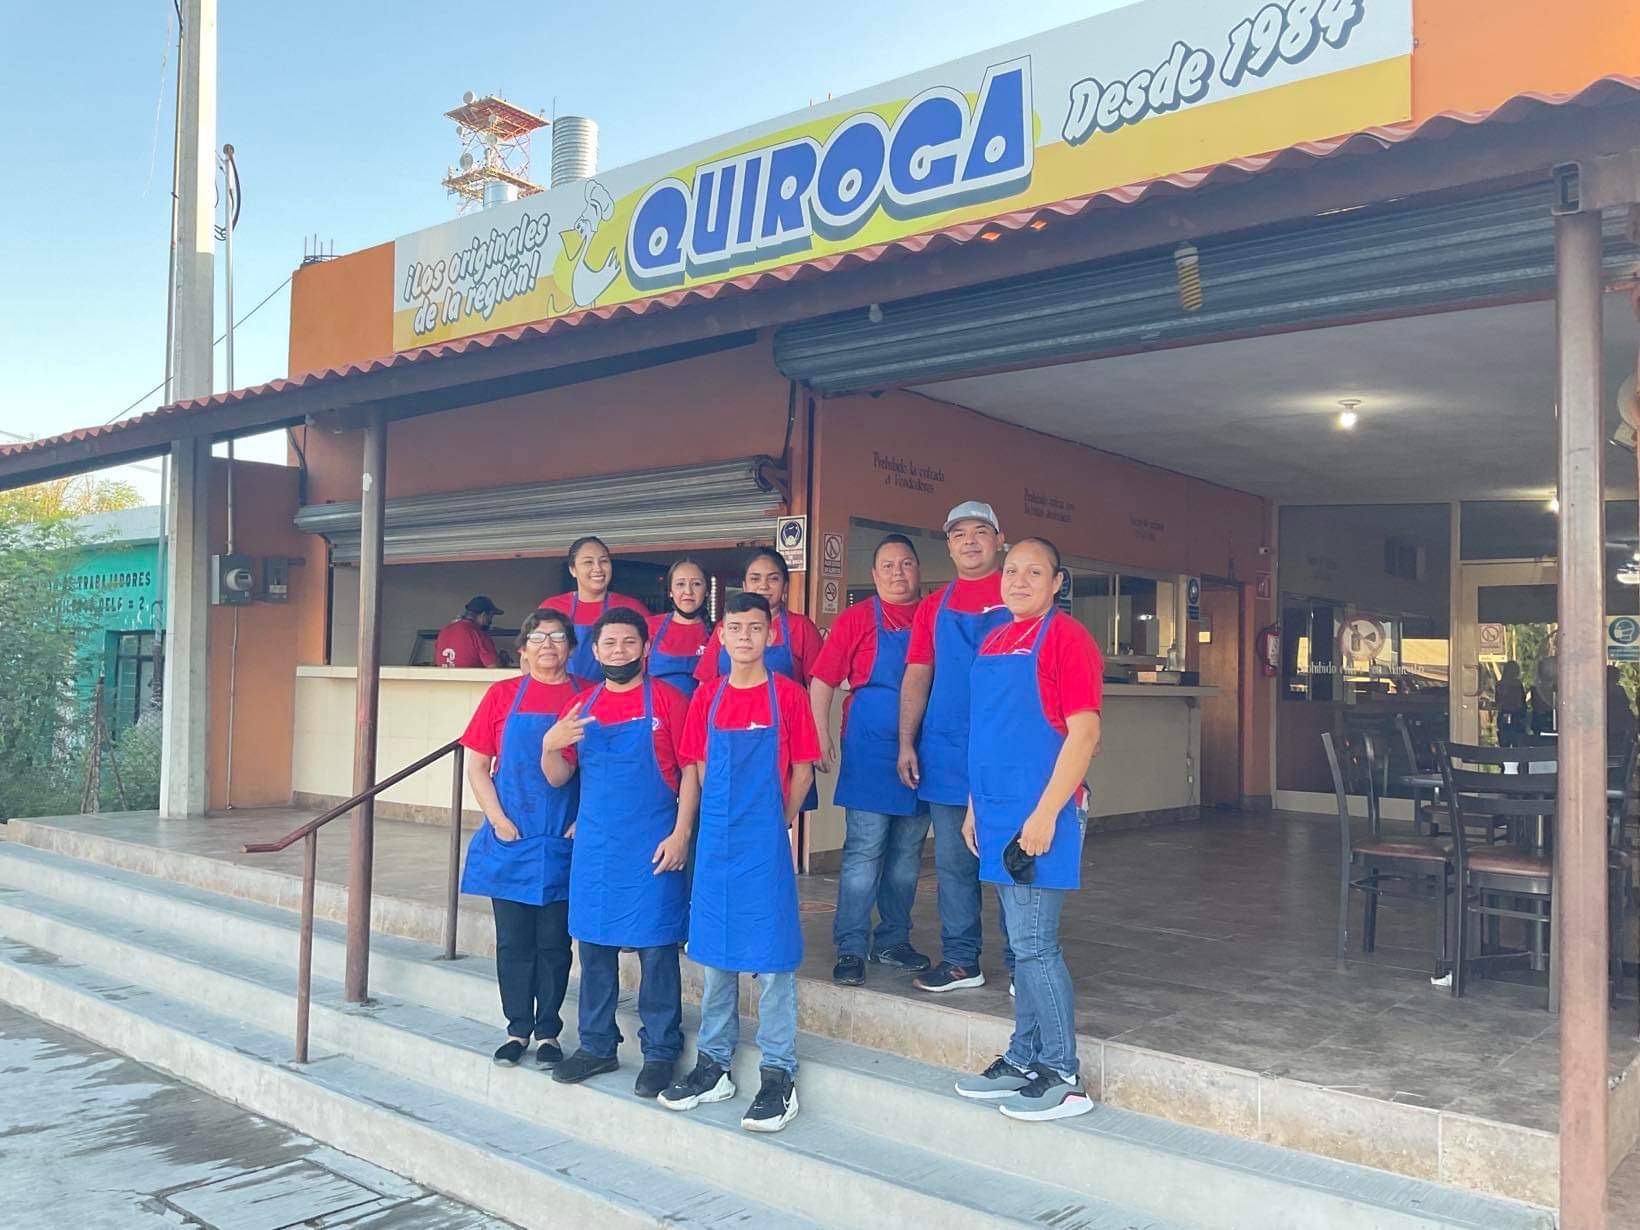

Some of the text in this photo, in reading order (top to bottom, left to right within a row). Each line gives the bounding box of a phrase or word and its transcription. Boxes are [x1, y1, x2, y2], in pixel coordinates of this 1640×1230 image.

[1062, 0, 1366, 147] Desde 1984
[626, 56, 1033, 290] QUIROGA
[404, 213, 550, 303] ¡Los originales
[413, 251, 540, 335] de la región!
